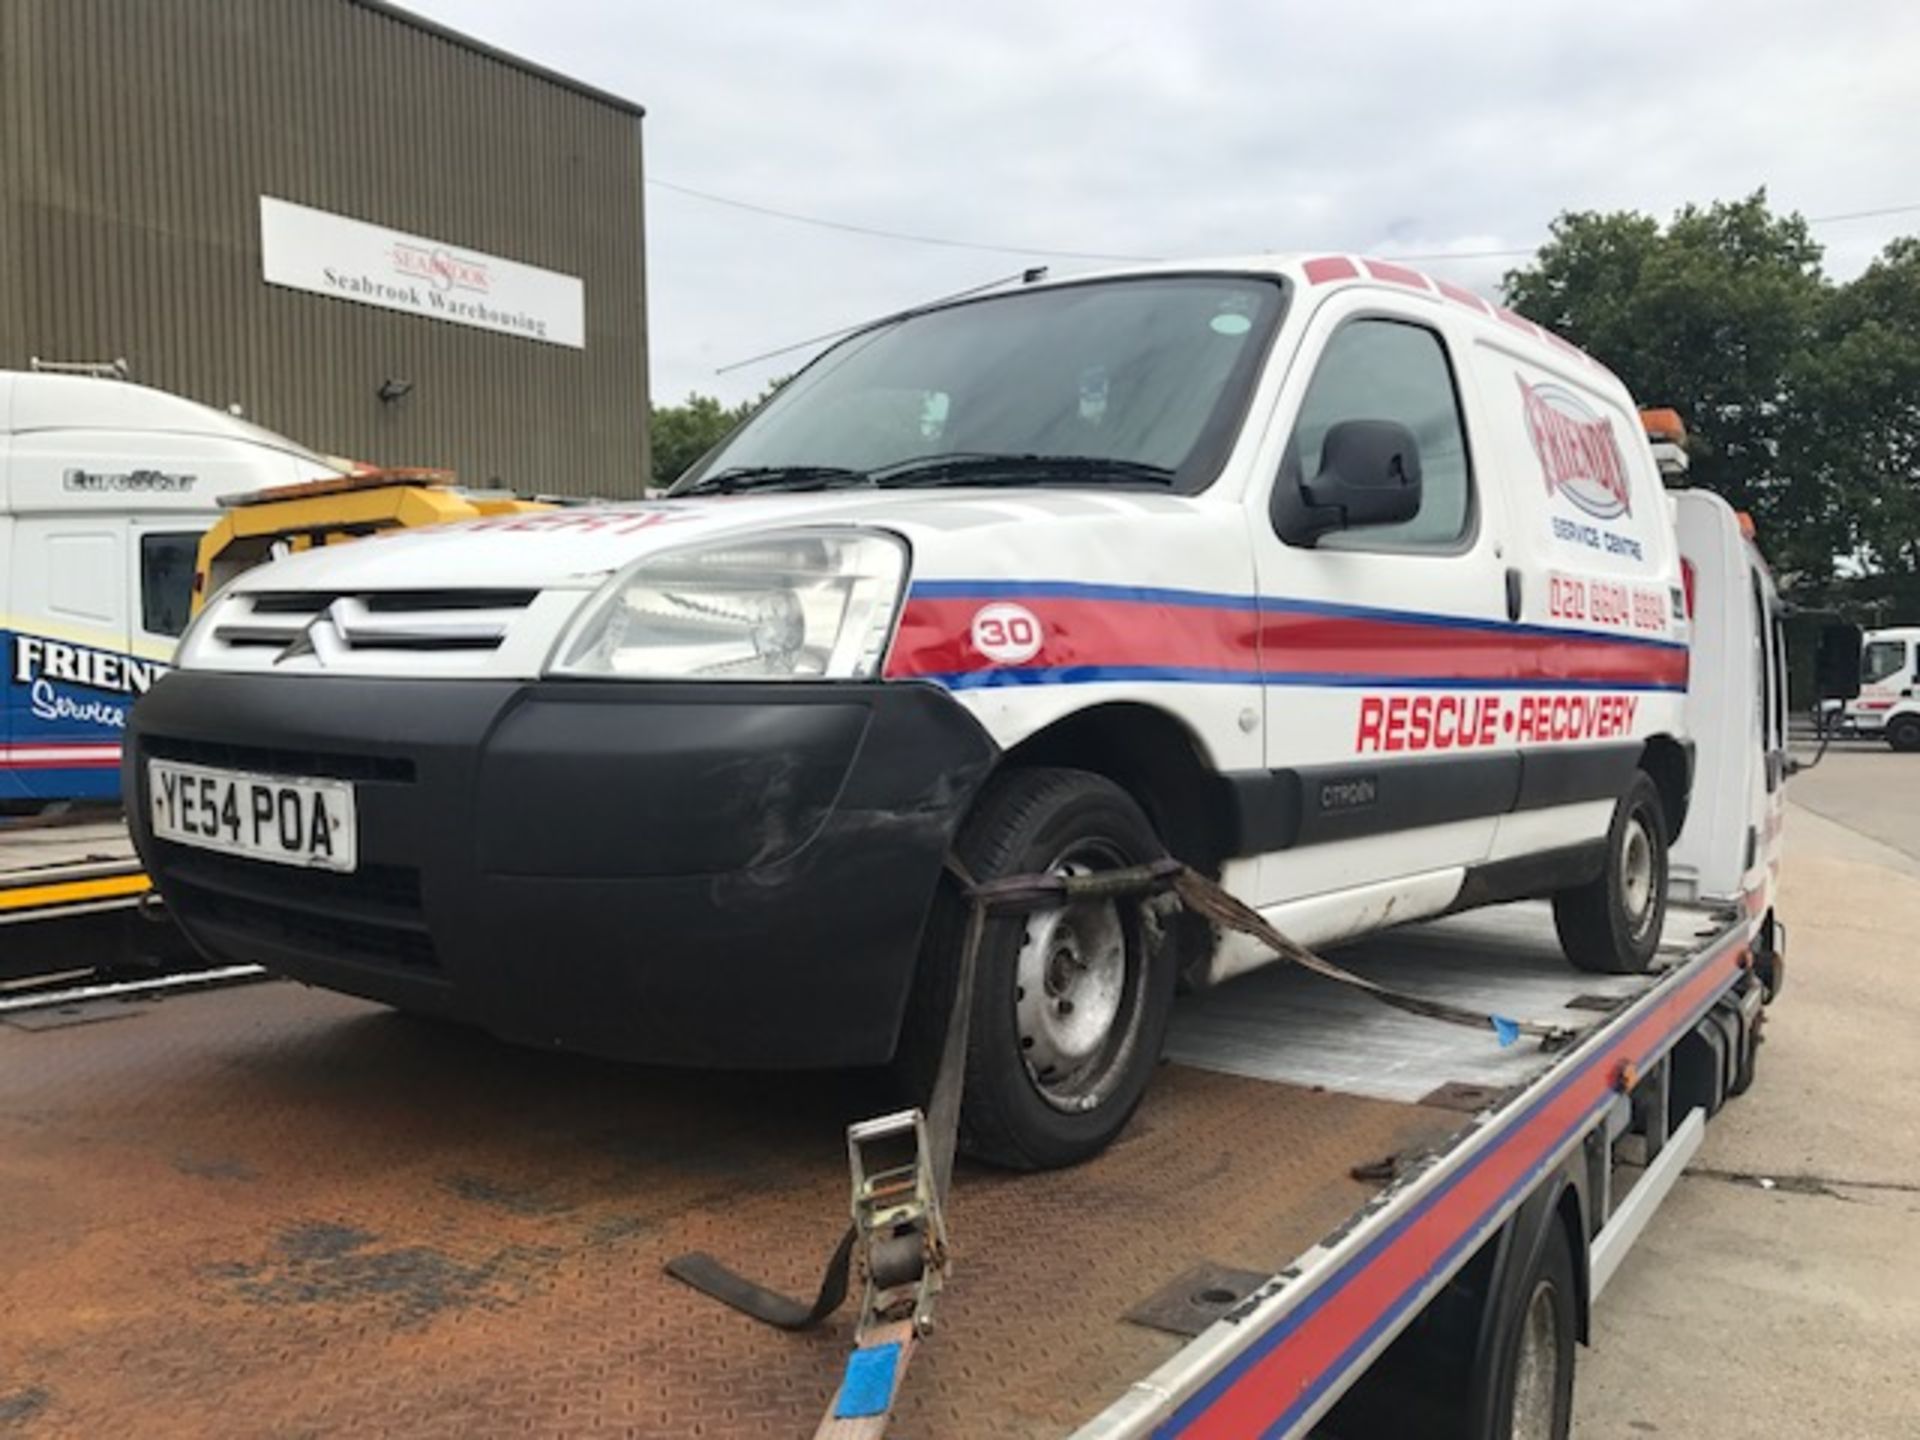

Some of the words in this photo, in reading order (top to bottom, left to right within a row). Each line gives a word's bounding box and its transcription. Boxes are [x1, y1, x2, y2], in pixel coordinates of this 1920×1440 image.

[322, 266, 422, 306] Seabrook
[428, 289, 548, 337] Warehousing
[1551, 577, 1585, 619] 020
[981, 618, 1033, 646] 30
[31, 679, 126, 729] Service
[1356, 697, 1500, 753] RESCUE
[1517, 696, 1638, 742] RECOVERY
[161, 771, 240, 842] YE54
